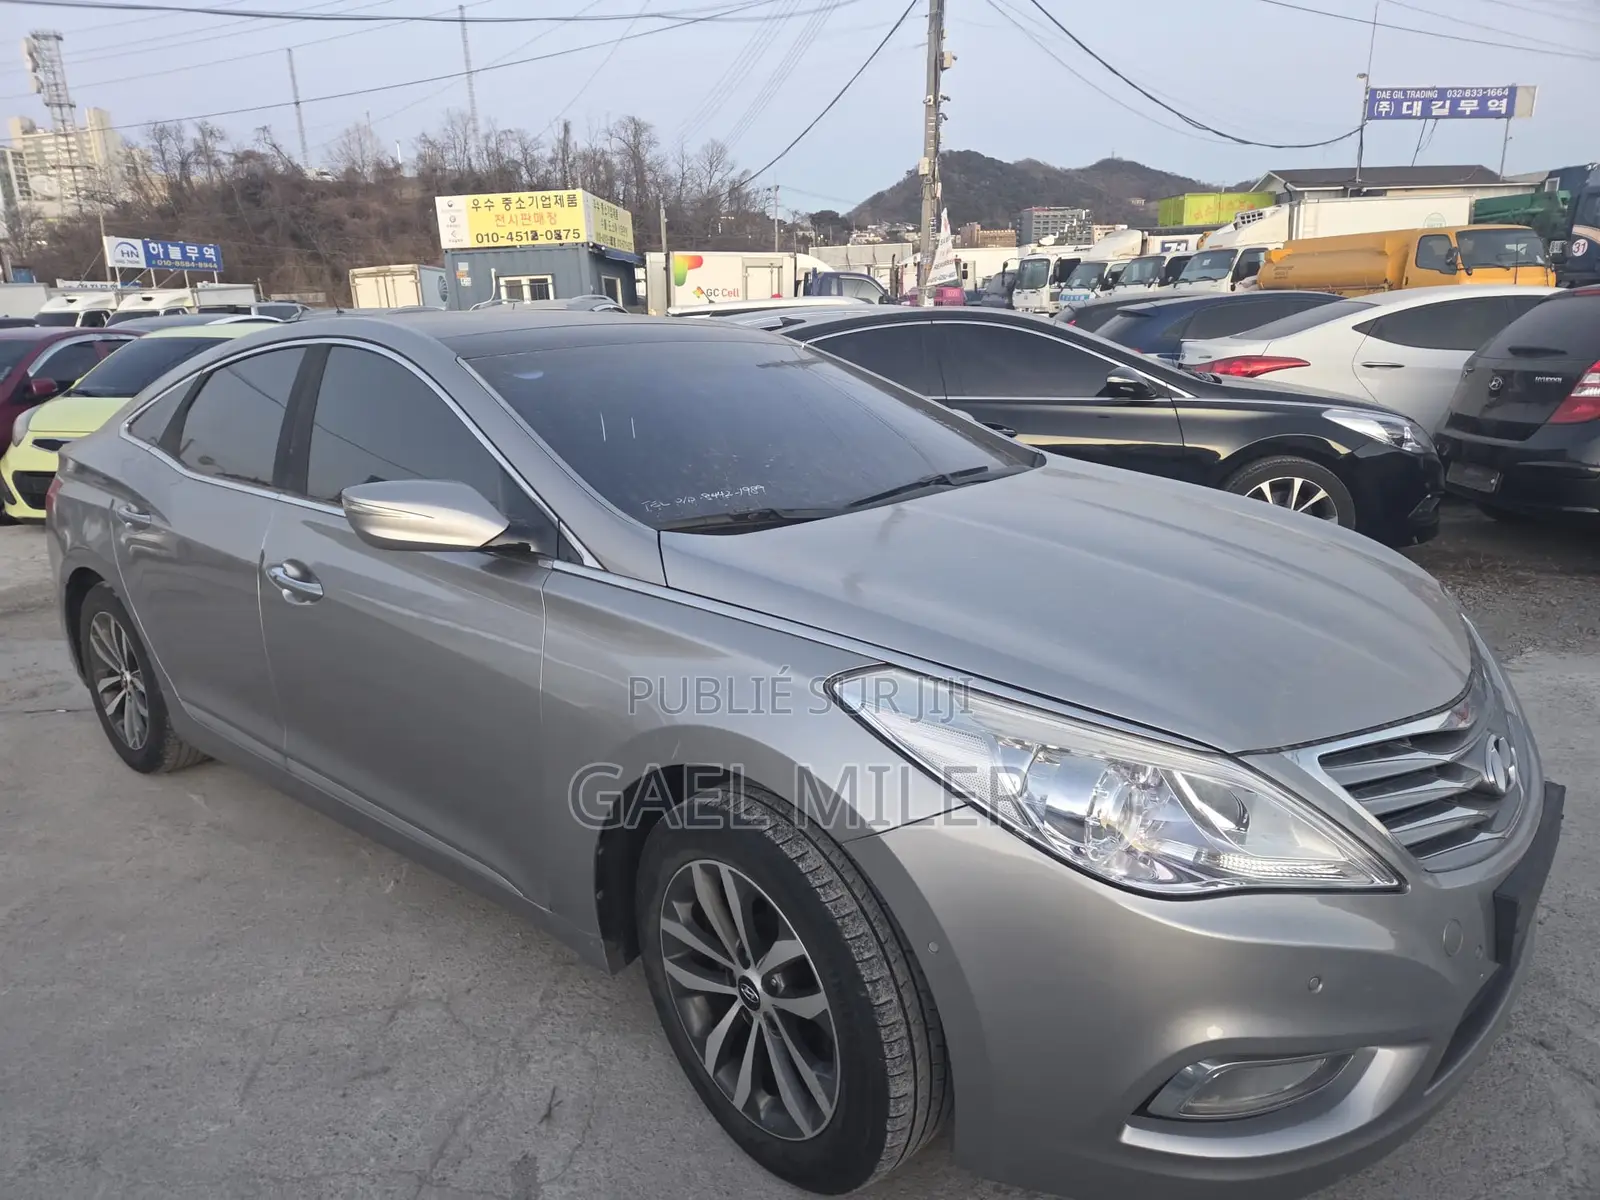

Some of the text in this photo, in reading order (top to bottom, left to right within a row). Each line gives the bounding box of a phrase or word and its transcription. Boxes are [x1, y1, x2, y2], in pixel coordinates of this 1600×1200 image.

[1376, 90, 1391, 99] DAE
[1393, 90, 1405, 99] GIL
[1407, 90, 1438, 98] TRADING
[1374, 101, 1395, 116] (주)
[472, 198, 495, 212] 우수
[501, 194, 578, 211] 중소기업제품
[495, 211, 557, 227] 전시판매장
[120, 249, 140, 258] HN
[148, 242, 217, 262] 하늘무역
[1574, 242, 1587, 253] 31
[706, 288, 740, 298] GC Cell
